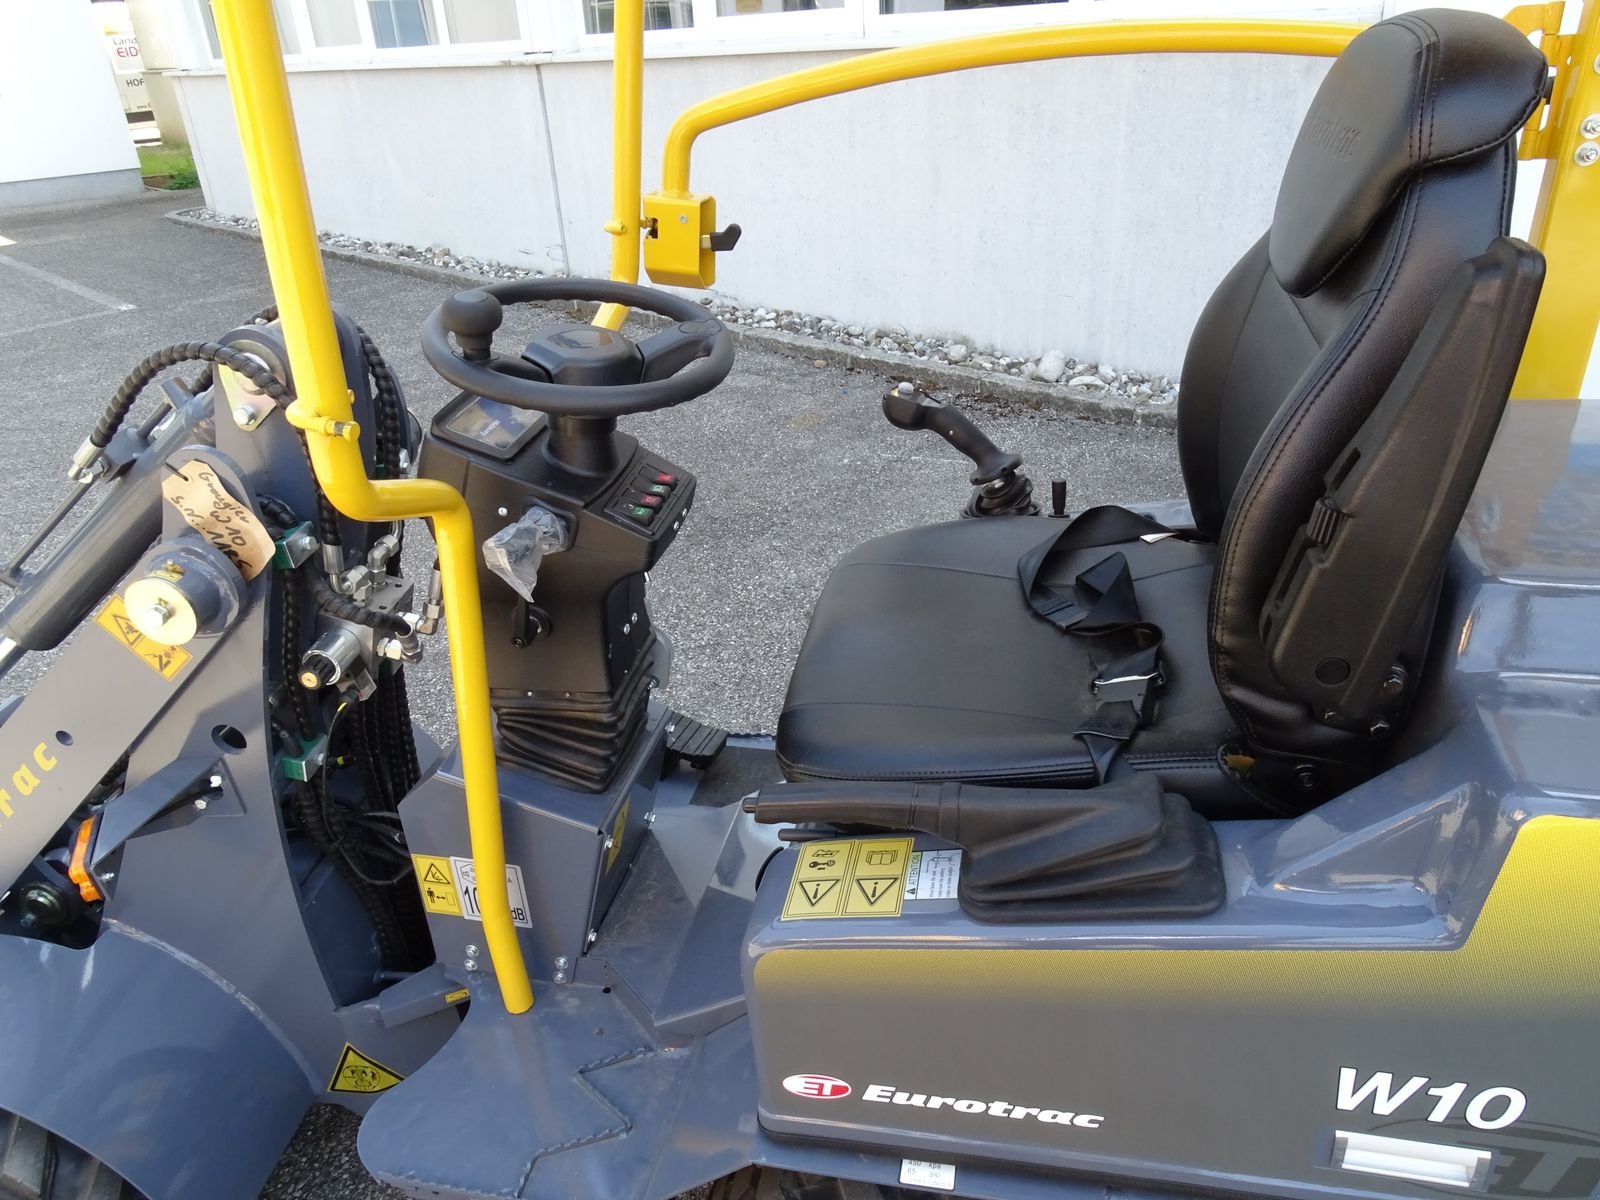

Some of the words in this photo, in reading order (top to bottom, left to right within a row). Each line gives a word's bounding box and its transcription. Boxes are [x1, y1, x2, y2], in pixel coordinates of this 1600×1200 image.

[0, 742, 58, 828] rac
[862, 1085, 1104, 1129] Eurotrac
[1336, 1066, 1527, 1130] W10
